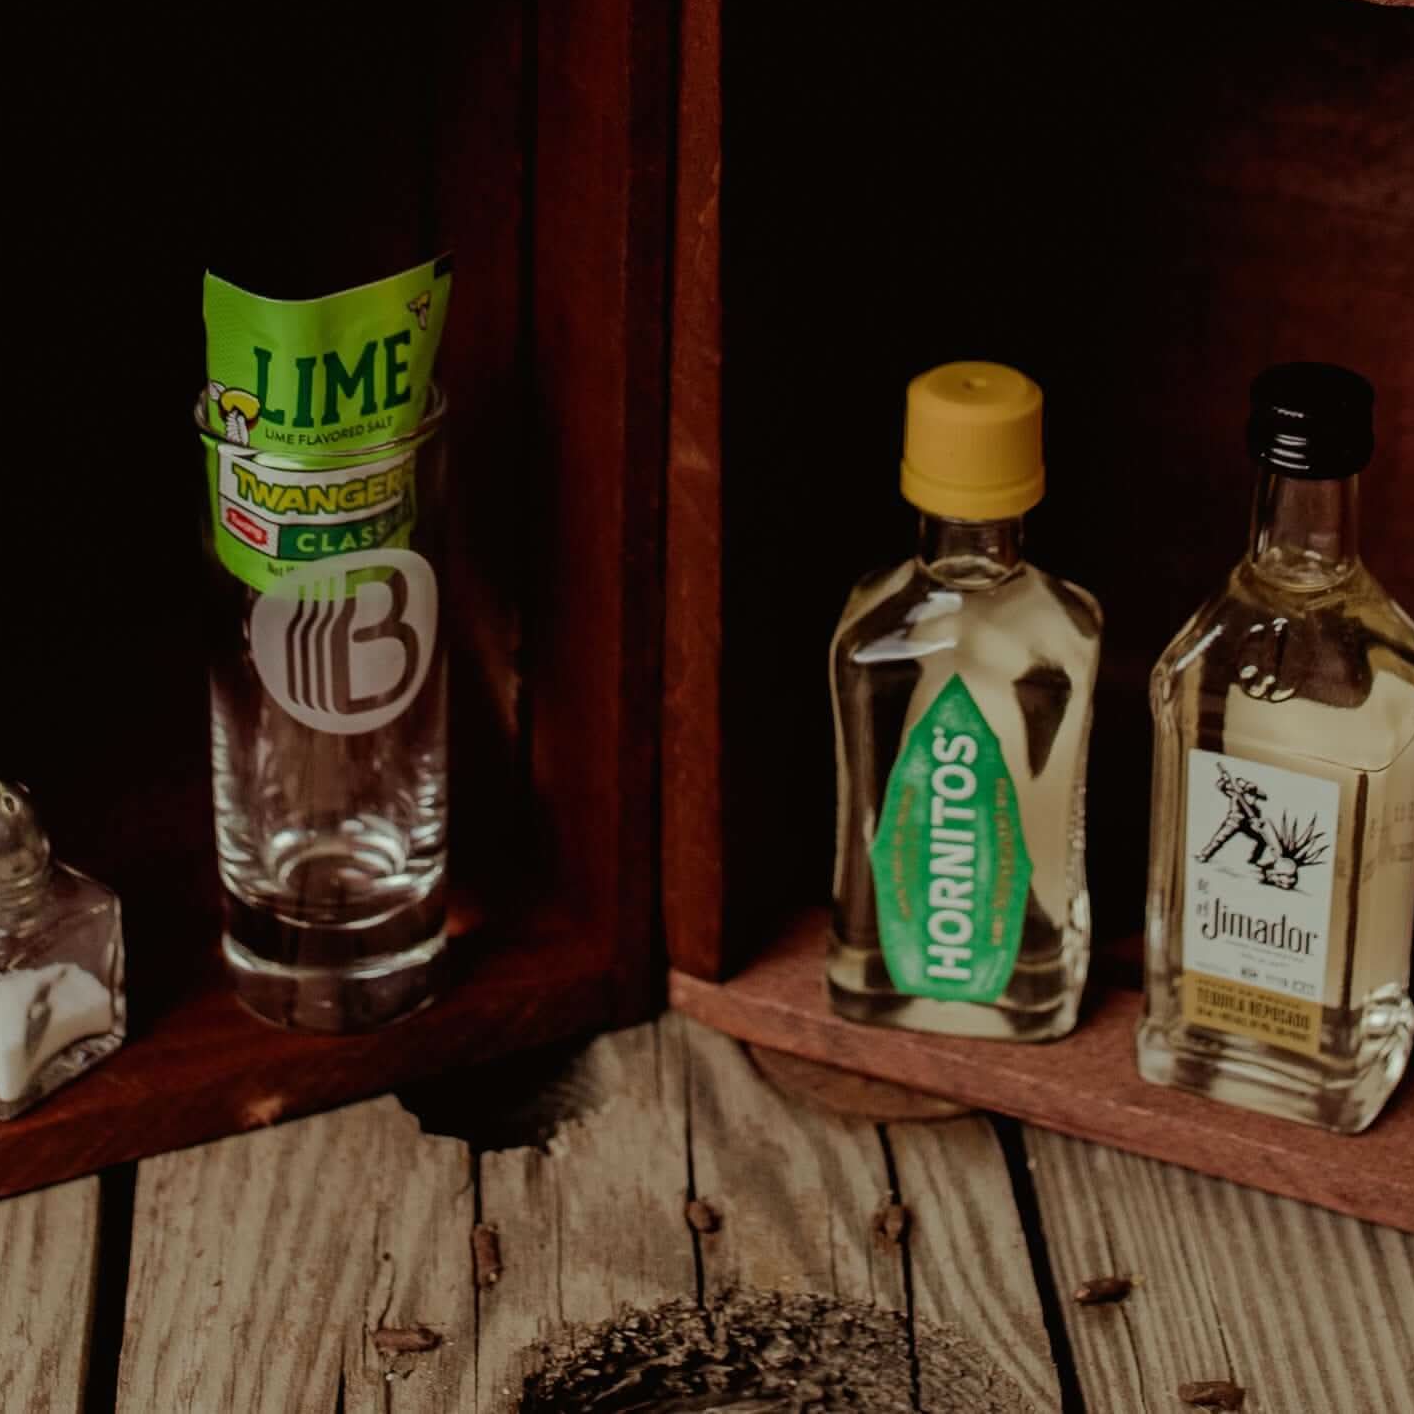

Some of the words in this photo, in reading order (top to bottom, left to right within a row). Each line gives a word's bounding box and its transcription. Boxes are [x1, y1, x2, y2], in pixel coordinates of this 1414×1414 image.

[253, 330, 411, 428] LIME
[265, 428, 294, 445] LIME
[298, 425, 364, 447] FLAVORED
[367, 416, 394, 433] SALT
[927, 733, 979, 984] HORNITOS
[1201, 897, 1319, 955] Jimador
